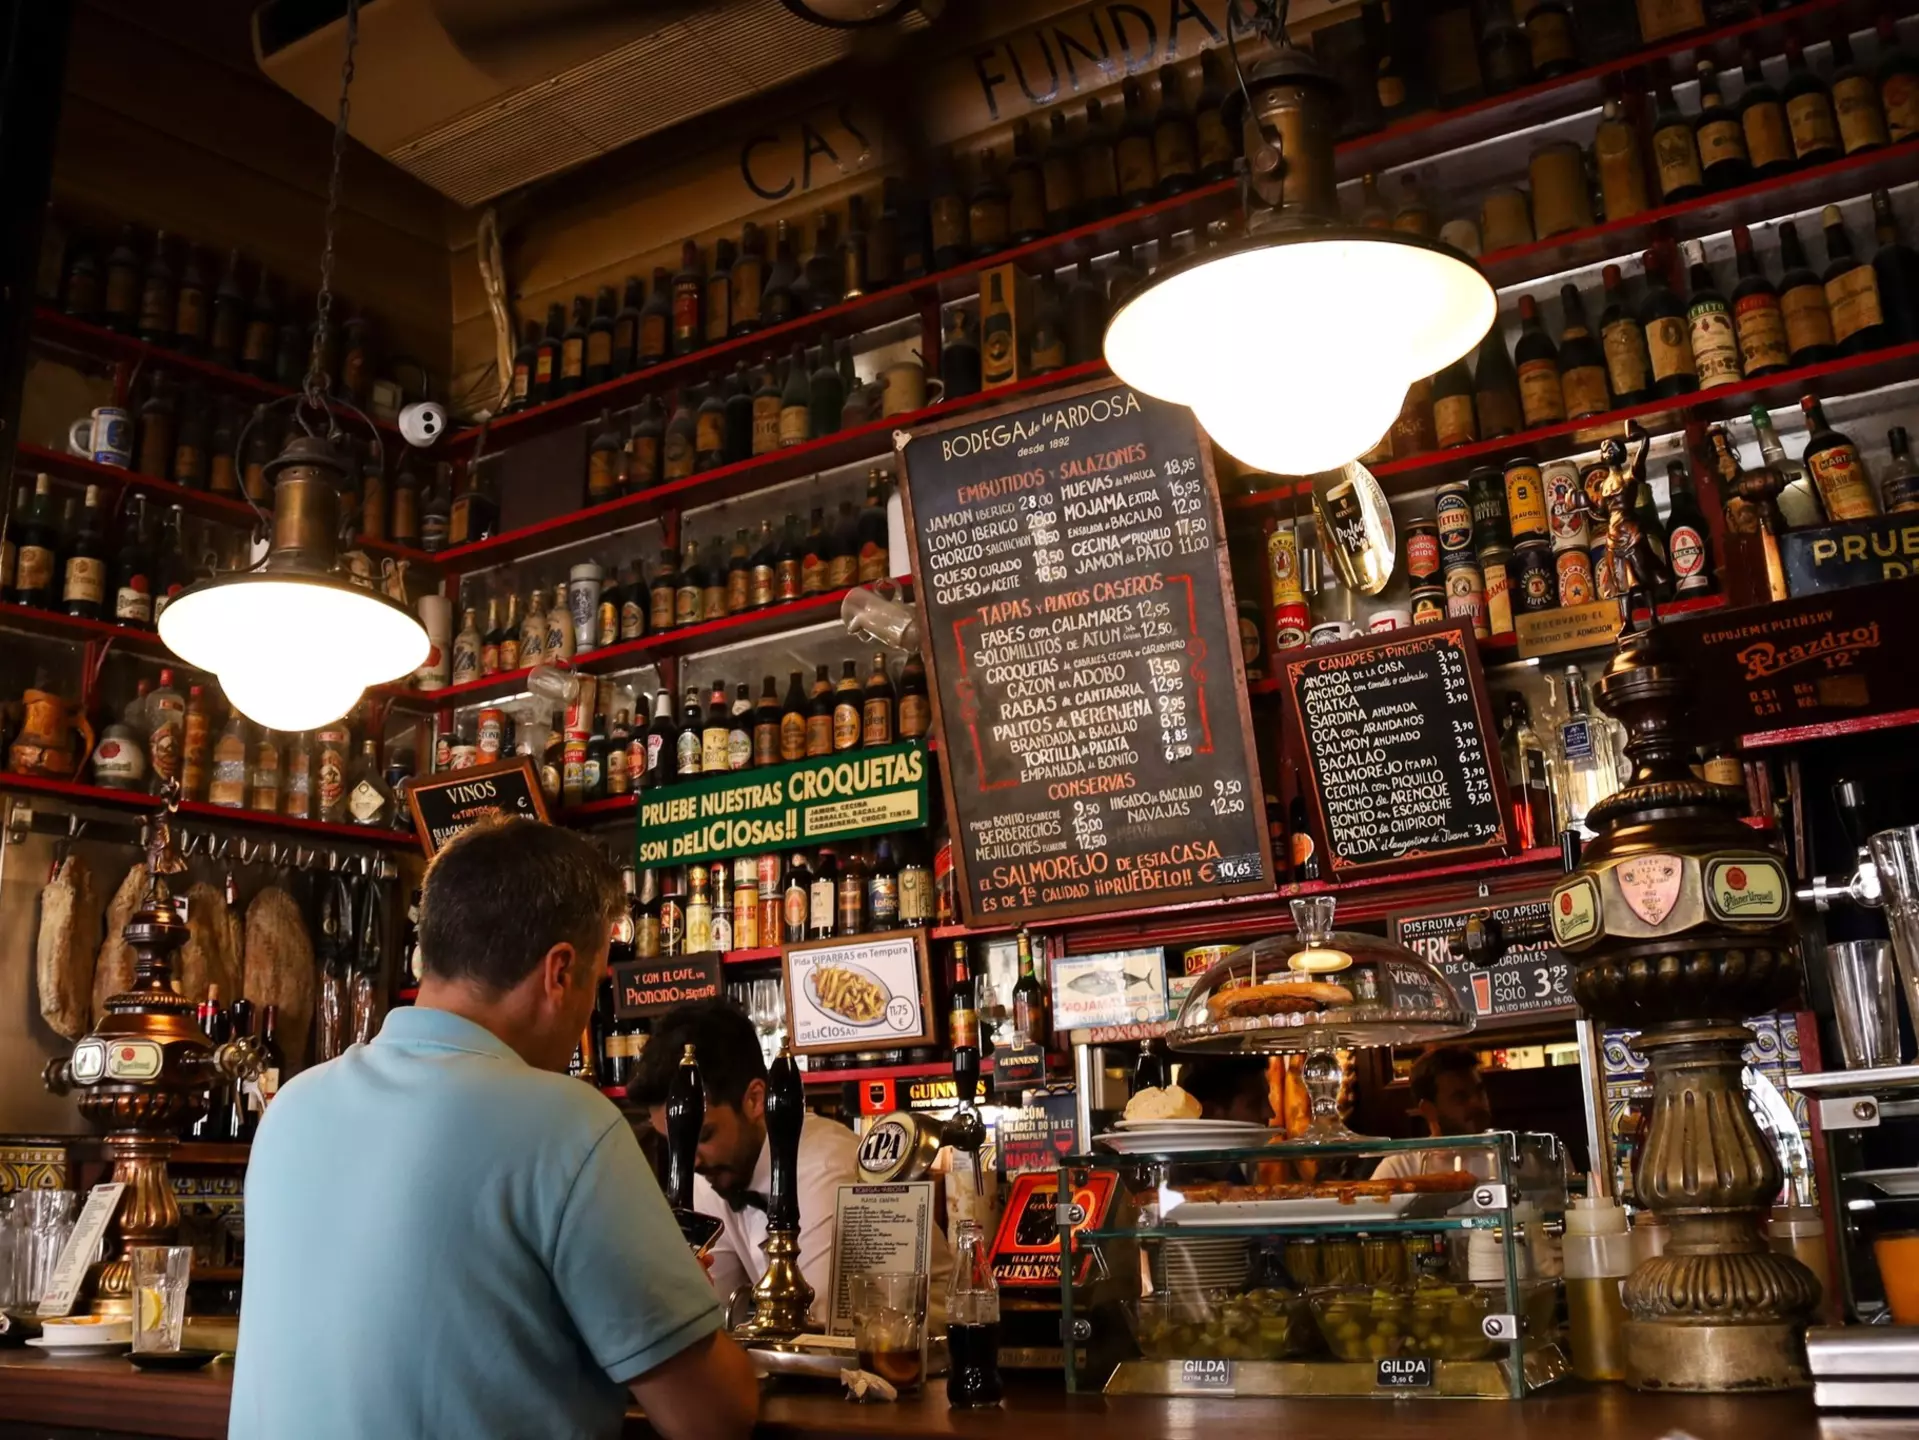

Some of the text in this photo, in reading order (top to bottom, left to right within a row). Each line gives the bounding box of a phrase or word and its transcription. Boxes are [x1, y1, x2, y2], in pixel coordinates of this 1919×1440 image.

[942, 392, 1141, 461] BODEGA ARDOSA
[957, 443, 1147, 505] EMBUTIDOS SALAZONES
[1060, 457, 1196, 501] HUEVAS 18,95
[1063, 479, 1201, 522] MOJAMA EXTRA 16,95
[925, 509, 974, 533] JAMON
[1110, 505, 1162, 530] BACALAO
[927, 517, 1018, 553] LOMO IBERICO
[1071, 517, 1207, 557] CECINA 17,50
[1075, 540, 1173, 575] JAMON PATO
[933, 558, 1023, 587] QUESO CURADO
[936, 582, 981, 605] QUESO
[977, 572, 1164, 626] TAPAS PLATOS CASEROS
[980, 625, 1025, 649] FABES
[1052, 604, 1132, 634] CALAMARES
[1136, 600, 1170, 618] 12,95
[973, 637, 1062, 667] SOLOMILLITOS
[1082, 627, 1121, 648] ATUN
[1318, 639, 1436, 671] CANAPES PINCHOS
[1736, 621, 1881, 681] Prazdroj
[986, 657, 1059, 684] CROQUETAS
[1007, 664, 1126, 699] CAZON ADOBO
[1303, 650, 1459, 690] ANCHOA CASA 3,90
[1305, 663, 1461, 703] ANCHOA 3,90
[1000, 682, 1145, 720] RABAS CANTABRIA
[1306, 677, 1465, 715] CHATKA 3,00
[1310, 691, 1468, 729] SARDINA AHUMADA 3,90
[993, 695, 1186, 742] PALITOS BERENJENA 9,95
[1312, 714, 1425, 743] OCA ARANDANOS
[1010, 719, 1138, 754] BRANDADA BACALAO
[1316, 720, 1474, 757] SALMON AHUMADO 3,90
[1021, 736, 1130, 768] TORTILLA PATATA
[1021, 745, 1192, 783] EMPANADA BONITO 6,50
[1319, 736, 1477, 773] BACALAO 3,90
[1048, 772, 1136, 801] CONSERVAS
[1322, 760, 1403, 786] SALMOREJO
[1325, 767, 1485, 800] CECINA PIQUILLO 3,90
[446, 780, 497, 805] VINOS
[642, 750, 923, 827] PRUEBE NUESTRAS CROQUETAS
[1159, 779, 1242, 804] BACALAO 9,50
[1328, 782, 1450, 815] PINCHO ARENQUE
[840, 801, 868, 811] CECINA
[852, 805, 887, 816] BACALAO
[861, 814, 887, 823] CHOCO
[889, 809, 912, 819] TINTA
[1074, 801, 1100, 818] 9,50
[1127, 797, 1245, 824] NAVAJAS 12,50
[1330, 792, 1491, 828] BONITO ESCABECHE 9,50
[639, 808, 797, 862] SON DELICIOSAS!!
[979, 820, 1061, 846] BERBERECHOS
[1332, 813, 1446, 842] PINCHO CHIPIRON
[975, 840, 1041, 862] MEJILLONES
[992, 840, 1222, 889] SALMOREJO ESTA CASA
[1403, 918, 1455, 933] DISFRUTA
[812, 952, 855, 965] PIPARRAS
[857, 951, 868, 959] en
[870, 946, 908, 959] Tempura
[1445, 964, 1459, 975] DE
[642, 972, 660, 984] CON
[662, 971, 672, 983] EL
[1494, 971, 1522, 987] POR
[1494, 986, 1527, 1003] SOLO
[1494, 1002, 1519, 1014] VALIDO
[1519, 1000, 1541, 1011] HASTA
[1000, 1055, 1039, 1066] GUINNESS
[1038, 1120, 1049, 1131] DO
[1061, 1119, 1074, 1129] LET
[862, 1132, 901, 1160] IPA
[1012, 1255, 1038, 1263] HALF
[1184, 1360, 1225, 1373] GILDA
[1381, 1360, 1426, 1373] GILDA
